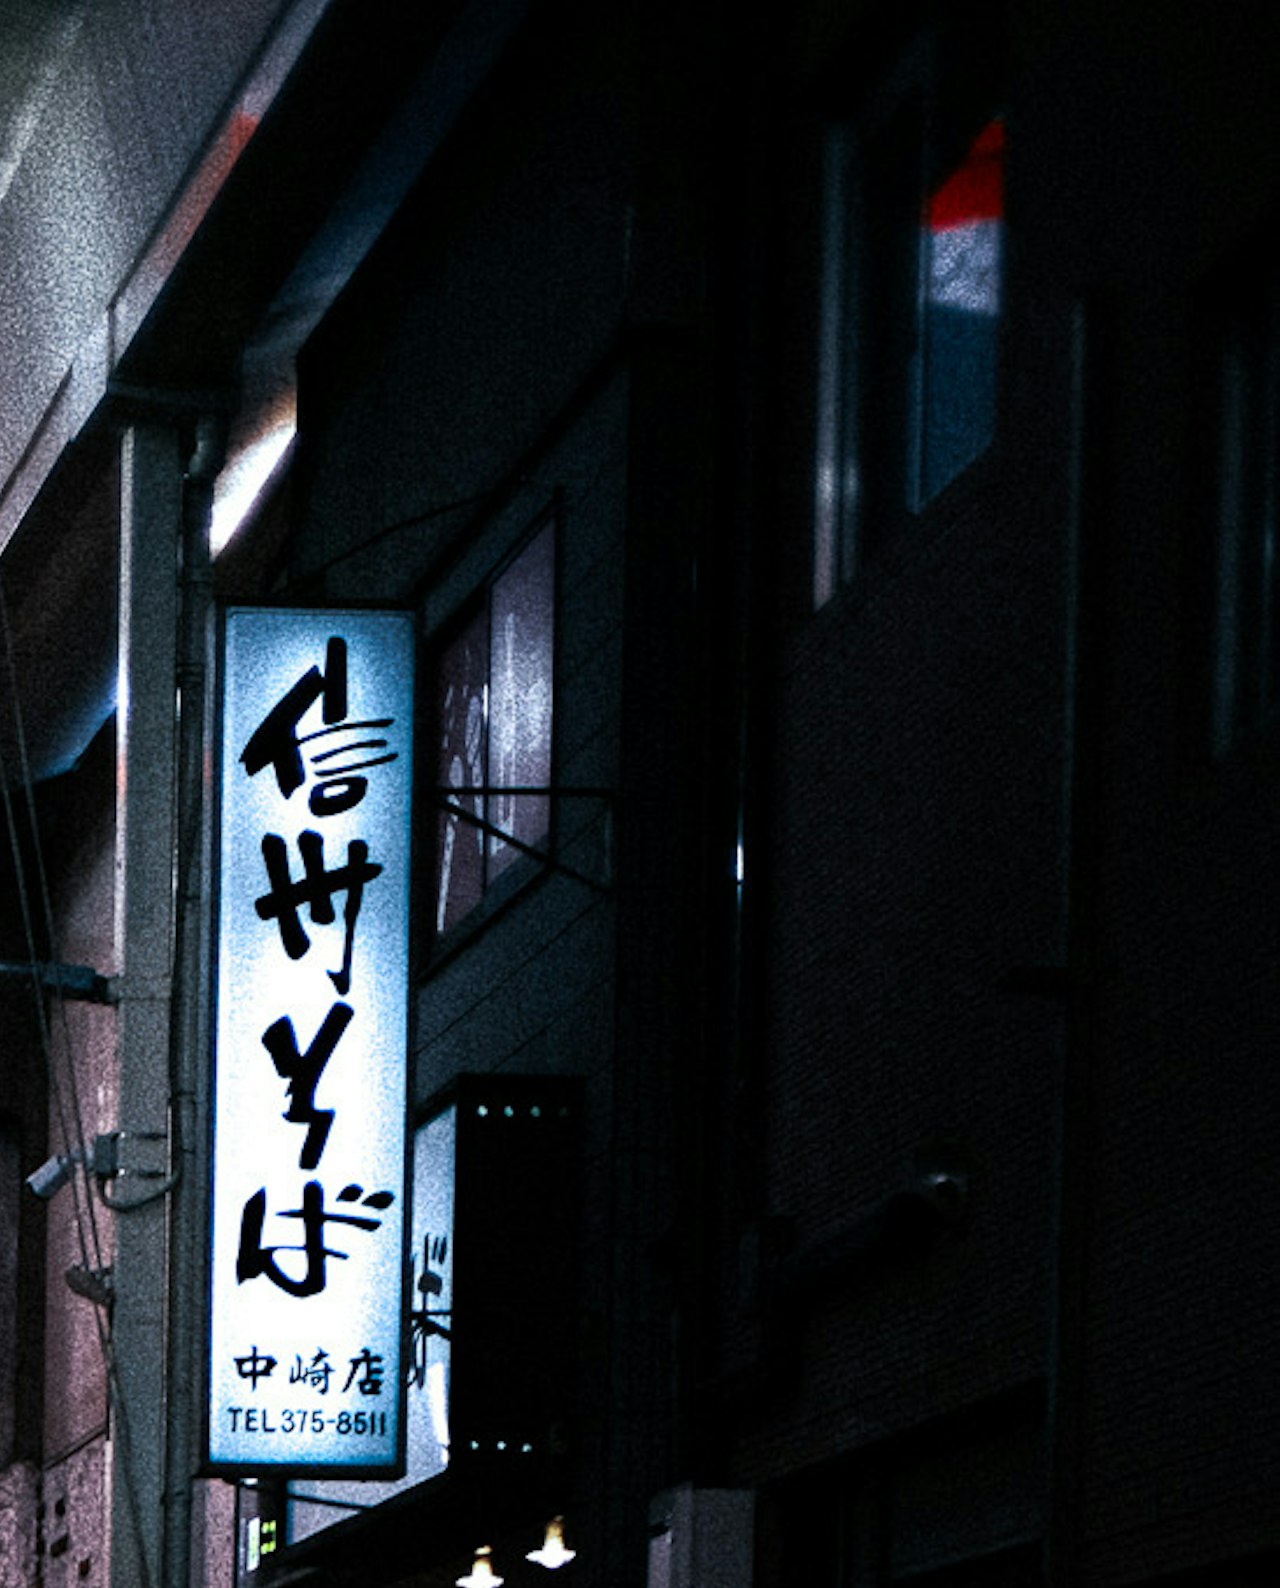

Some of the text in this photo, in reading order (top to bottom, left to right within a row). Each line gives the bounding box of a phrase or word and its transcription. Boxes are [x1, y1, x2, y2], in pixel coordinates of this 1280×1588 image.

[236, 635, 398, 1298] 信州そば
[233, 1345, 385, 1395] 中崎店
